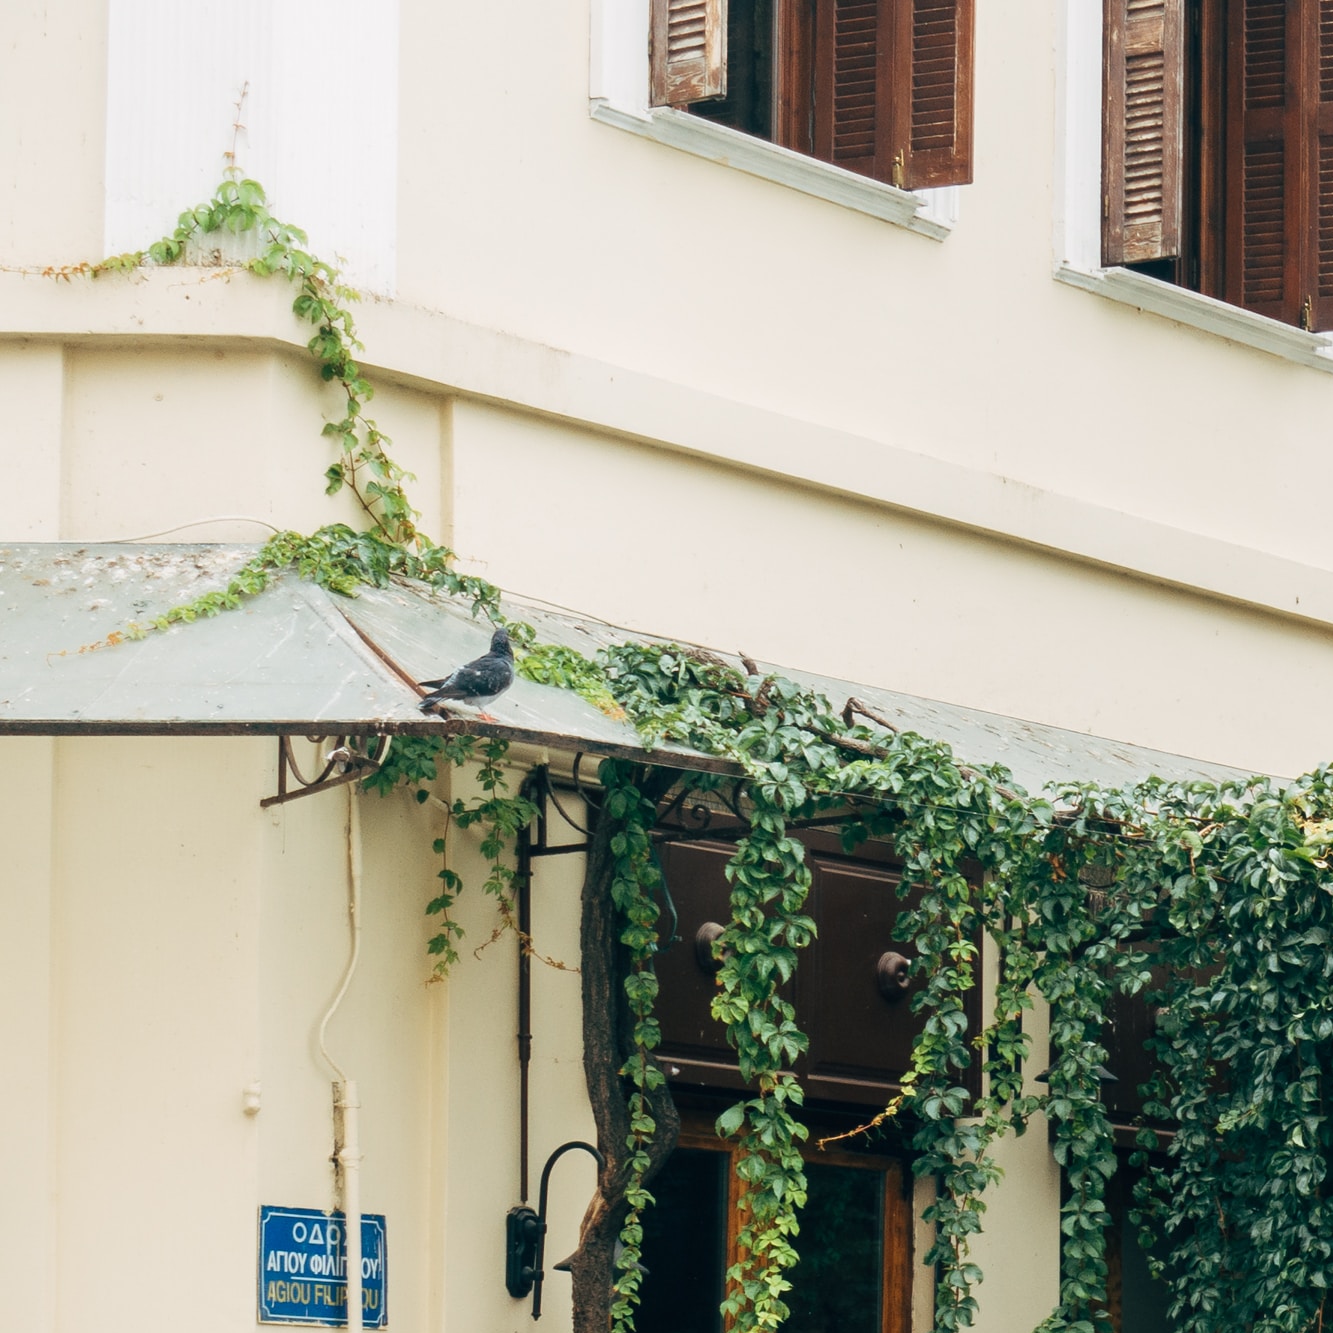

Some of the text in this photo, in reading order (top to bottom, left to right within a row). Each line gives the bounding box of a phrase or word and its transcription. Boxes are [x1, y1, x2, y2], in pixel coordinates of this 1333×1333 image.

[267, 1250, 378, 1280] ΑΓΙΟΥ ΦΙΛΙΠΟΥ
[267, 1280, 378, 1309] AGIOU FILIPOU
